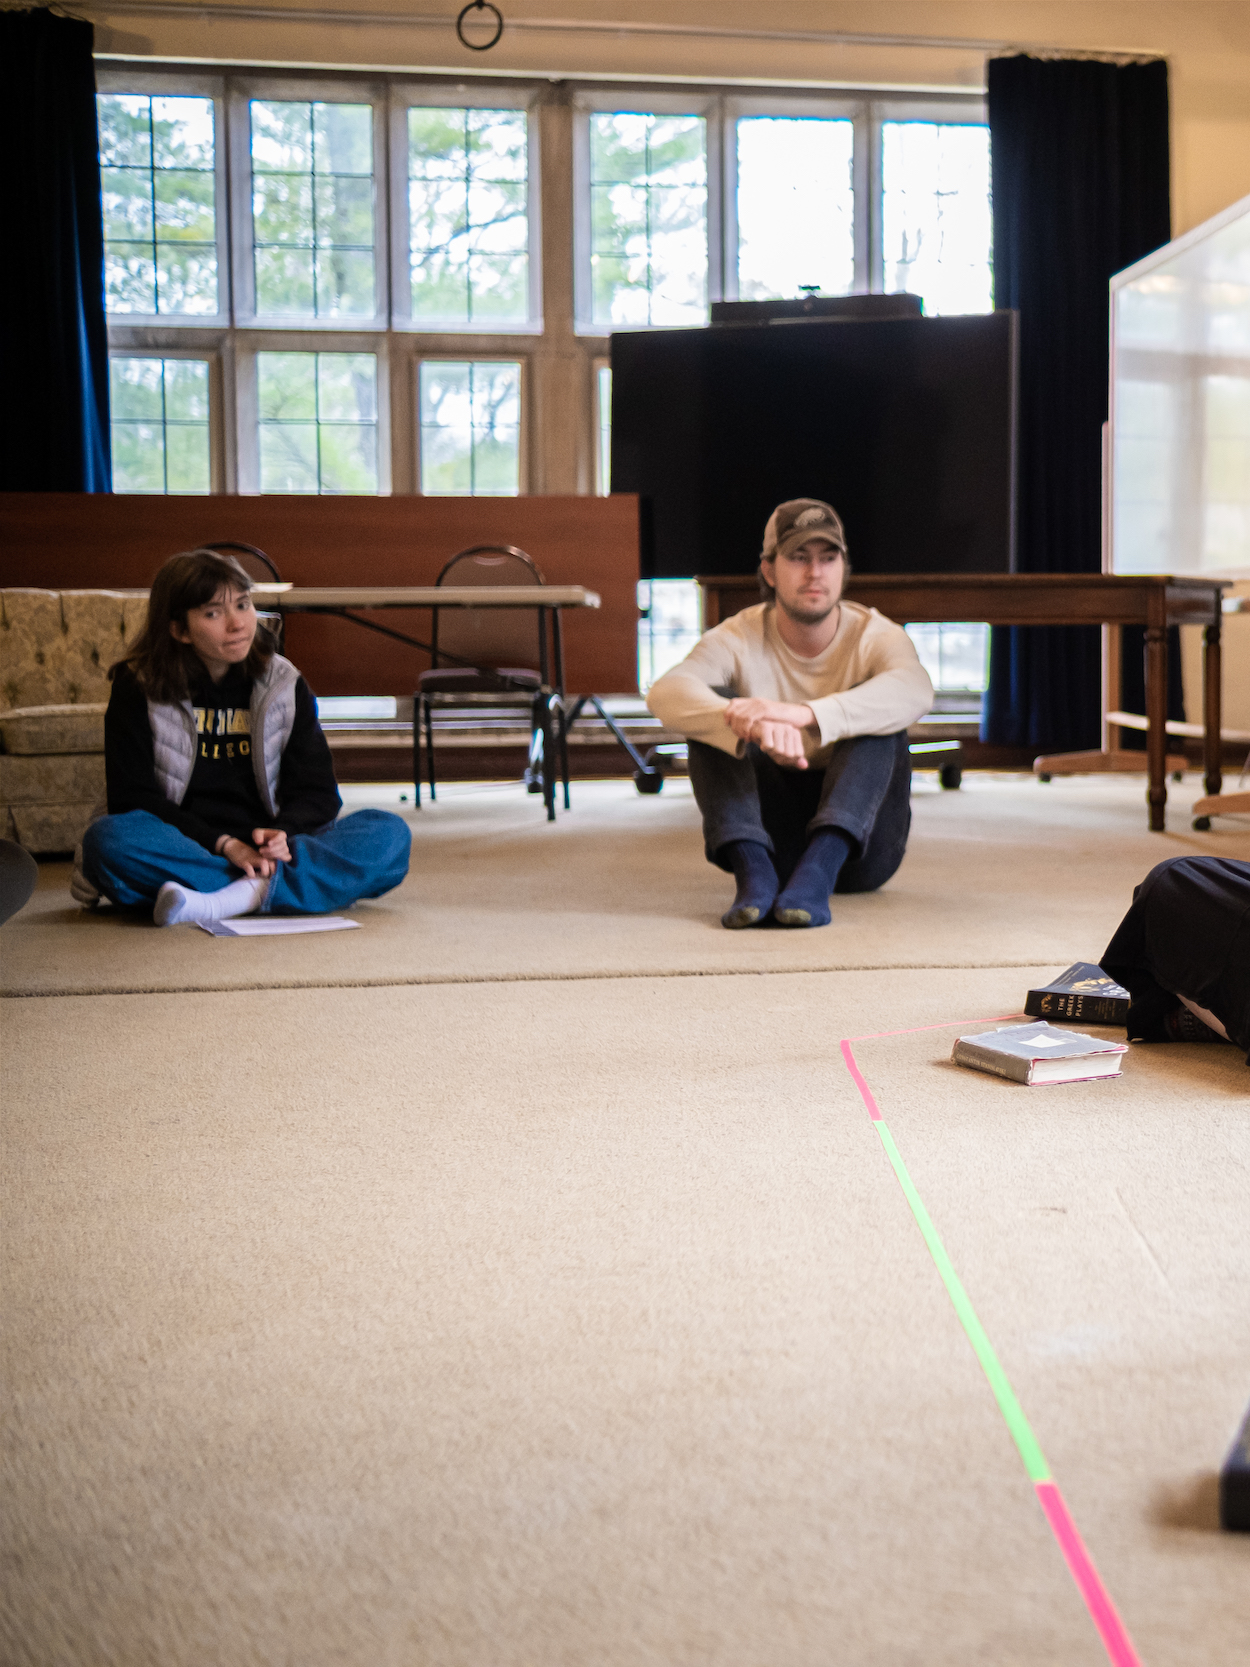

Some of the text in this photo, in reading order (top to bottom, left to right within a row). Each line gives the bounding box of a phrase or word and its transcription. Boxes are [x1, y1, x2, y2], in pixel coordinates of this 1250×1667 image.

[1058, 998, 1066, 1011] THE
[1066, 995, 1075, 1016] GREEK
[1075, 995, 1084, 1017] PLAYS
